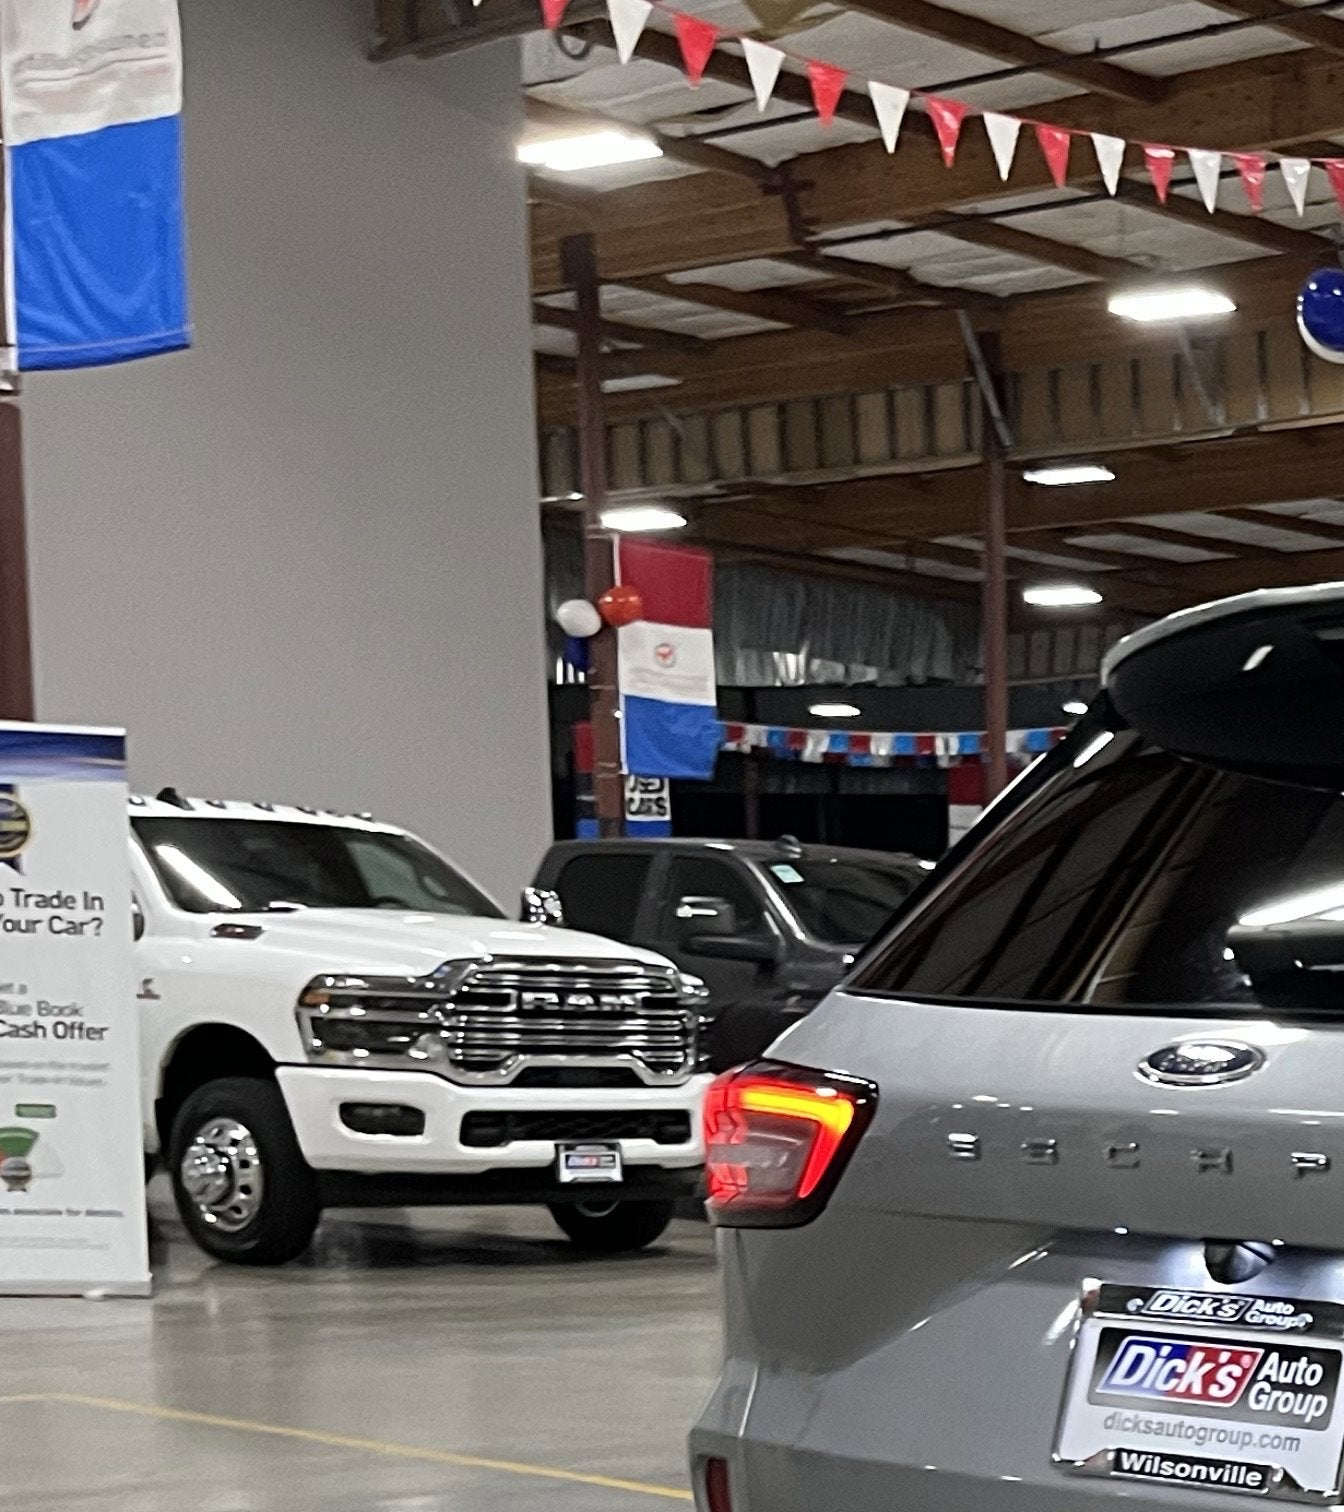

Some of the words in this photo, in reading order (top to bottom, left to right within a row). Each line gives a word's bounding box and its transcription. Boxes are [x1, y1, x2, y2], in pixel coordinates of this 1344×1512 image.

[10, 887, 77, 910] Trade
[83, 891, 105, 910] In
[48, 915, 104, 936] Car?
[52, 1021, 110, 1041] Offer
[1149, 1294, 1241, 1318] Dick's
[1250, 1299, 1296, 1316] Auto
[1109, 1343, 1245, 1398] Dick's
[1256, 1351, 1324, 1387] Auto
[1248, 1385, 1329, 1424] Group
[1103, 1411, 1301, 1453] dicksautogroup.com
[1120, 1451, 1263, 1488] Wilsonville
